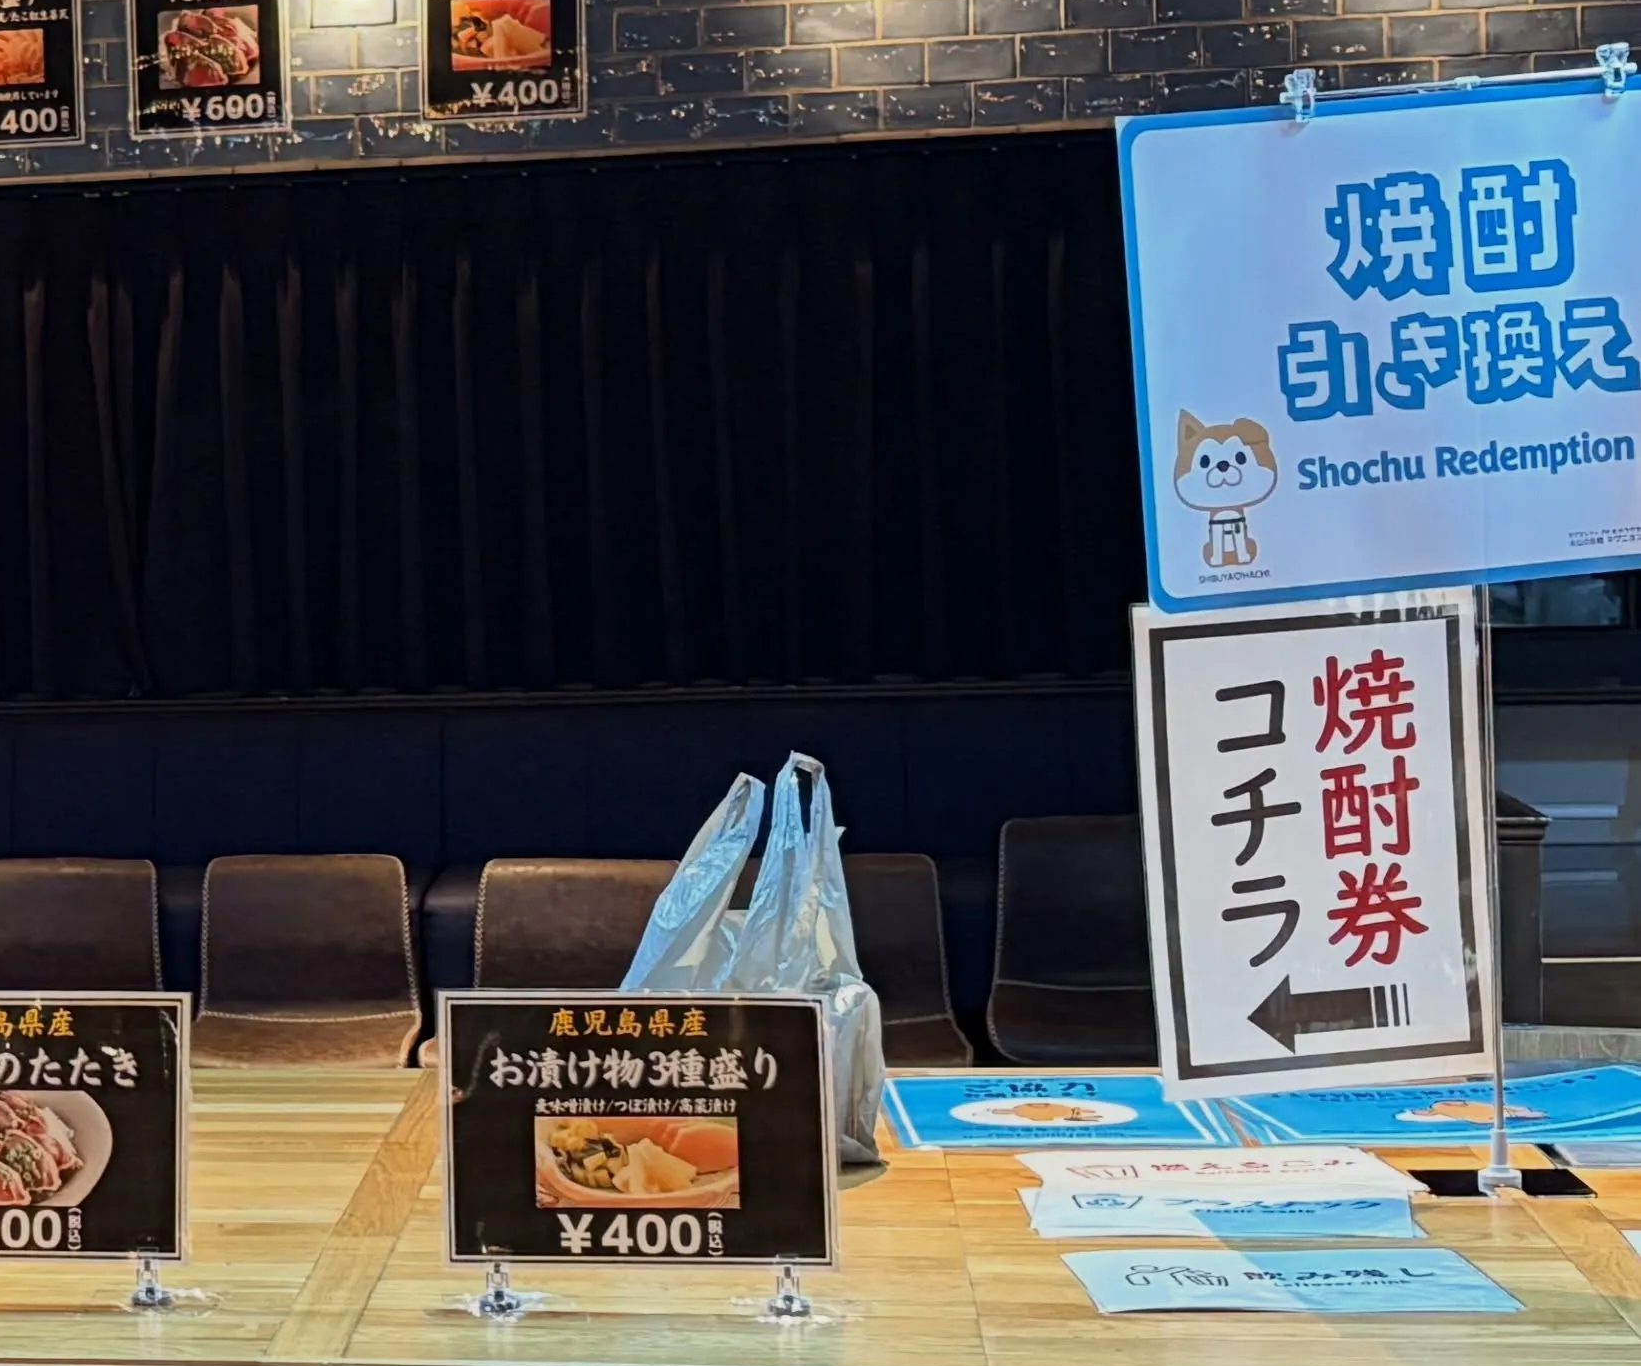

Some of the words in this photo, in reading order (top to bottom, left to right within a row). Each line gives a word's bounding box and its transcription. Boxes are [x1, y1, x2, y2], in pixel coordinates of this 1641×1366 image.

[180, 93, 264, 121] ¥600
[471, 79, 558, 107] ¥400
[1324, 158, 1577, 301] 焼酎
[1277, 296, 1641, 422] 引き換え
[1297, 450, 1426, 491] Shochu
[1436, 432, 1635, 478] Redemption
[1211, 679, 1301, 968] コチラ
[1312, 648, 1430, 968] 焼酎券
[549, 1007, 708, 1037] 鹿児島県産
[489, 1046, 778, 1091] お漬け物3種盛り
[557, 1213, 702, 1255] ¥400
